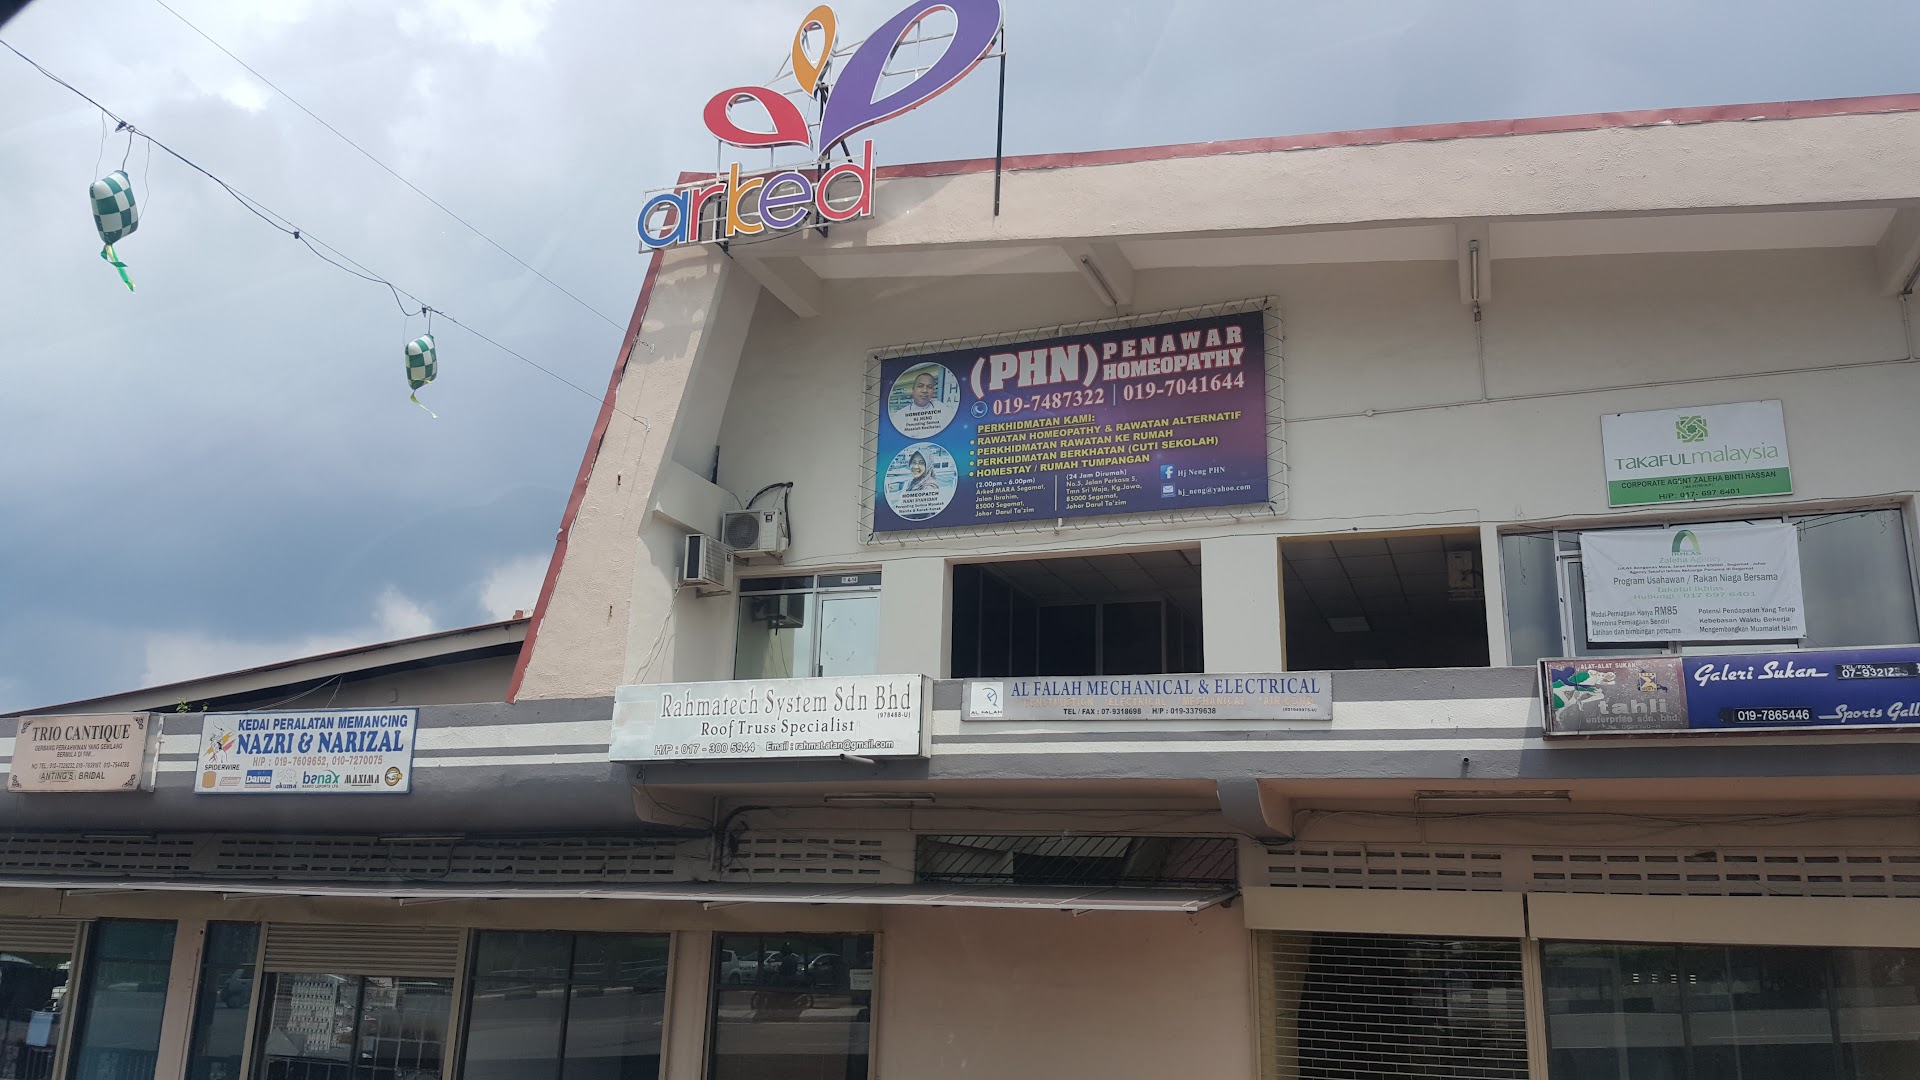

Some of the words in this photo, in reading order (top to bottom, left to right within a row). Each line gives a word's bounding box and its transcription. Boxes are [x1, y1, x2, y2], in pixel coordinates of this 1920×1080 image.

[637, 139, 873, 248] arked
[970, 343, 1099, 399] (PHN)
[1102, 325, 1243, 360] PENAWAR
[1102, 347, 1244, 381] HOMEOPATHY
[993, 388, 1105, 415] 019-7487322
[1123, 371, 1245, 401] 019-7041644
[977, 417, 1060, 433] PERKHIDMATAN
[1063, 413, 1095, 424] KAMI:
[977, 433, 1026, 445] RAWATAN
[1029, 425, 1101, 440] HOMEOPATHY
[1104, 424, 1113, 433] &
[1115, 418, 1169, 431] RAWATAN
[1172, 410, 1241, 425] ALTERNATIF
[977, 441, 1057, 456] PERKHIDMATAN
[1060, 434, 1112, 447] RAWATAN
[1115, 433, 1130, 443] KE
[1133, 429, 1174, 441] RUMAH
[976, 451, 1057, 467] PERKHIDMATAN
[1060, 445, 1125, 459] BERKHATAN
[1128, 442, 1159, 454] (CUTI
[1161, 436, 1219, 449] SEKOLAH)
[976, 465, 1032, 477] HOMESTAY
[1040, 460, 1078, 472] RUMAH
[1081, 454, 1150, 468] TUMPANGAN
[1095, 469, 1127, 478] Dirumah)
[1208, 465, 1226, 474] PHN
[1621, 478, 1666, 489] CORPORATE
[1667, 476, 1693, 486] AGENT
[1693, 474, 1724, 484] ZALEHA
[1724, 472, 1744, 481] BINTI
[1745, 470, 1777, 479] HASSAN
[1701, 489, 1717, 497] 697
[1719, 487, 1741, 495] 6401
[1613, 577, 1645, 587] Program
[1646, 575, 1685, 585] Usahawan
[1693, 574, 1718, 583] Rakan
[1719, 573, 1742, 584] Niaga
[1743, 572, 1779, 582] Bersama
[1654, 606, 1678, 616] RM85
[1761, 606, 1777, 614] Yang
[1656, 628, 1682, 636] percuma
[1781, 624, 1798, 632] Islam
[1580, 662, 1613, 670] ALAT-ALAT
[1614, 661, 1637, 669] SUKAN
[1694, 663, 1754, 687] Galeri
[1757, 660, 1830, 680] Sukan
[1010, 681, 1030, 697] AL
[1033, 681, 1082, 697] FALAH
[1086, 679, 1194, 696] MECHANICAL
[1198, 679, 1209, 695] &
[1214, 677, 1321, 695] ELECTRICAL
[660, 686, 759, 718] Rahmatech
[764, 688, 828, 721] System
[833, 682, 868, 712] Sdn
[874, 681, 912, 710] Bhd
[1598, 698, 1668, 715] tahli
[1170, 707, 1217, 715] 019-3379638
[1737, 709, 1810, 721] 019-7865446
[1818, 704, 1883, 723] Sports
[238, 718, 270, 731] KEDAI
[272, 717, 334, 731] PERALATAN
[337, 714, 408, 729] MEMANCING
[700, 719, 735, 738] Roof
[738, 719, 776, 735] Truss
[781, 716, 855, 737] Specialist
[1585, 715, 1633, 725] enterprise
[32, 726, 62, 741] TRIO
[65, 724, 131, 743] CANTIQUE
[236, 732, 295, 755] NAZRI
[297, 732, 314, 754] &
[317, 729, 405, 753] NARIZAL
[654, 744, 674, 755] H/P
[681, 743, 701, 755] 017
[708, 742, 728, 753] 300
[730, 741, 756, 753] 5944
[765, 740, 789, 751] Email
[795, 739, 895, 752] rahmat.atan@gmail.com
[274, 756, 329, 768] 019-7609652,
[331, 755, 383, 766] 010-7270075
[40, 771, 74, 780] ANTING'S
[78, 771, 106, 780] BRIDAL
[246, 775, 271, 783] Daiwa
[302, 769, 341, 785] banax
[344, 774, 380, 784] MAXIMA
